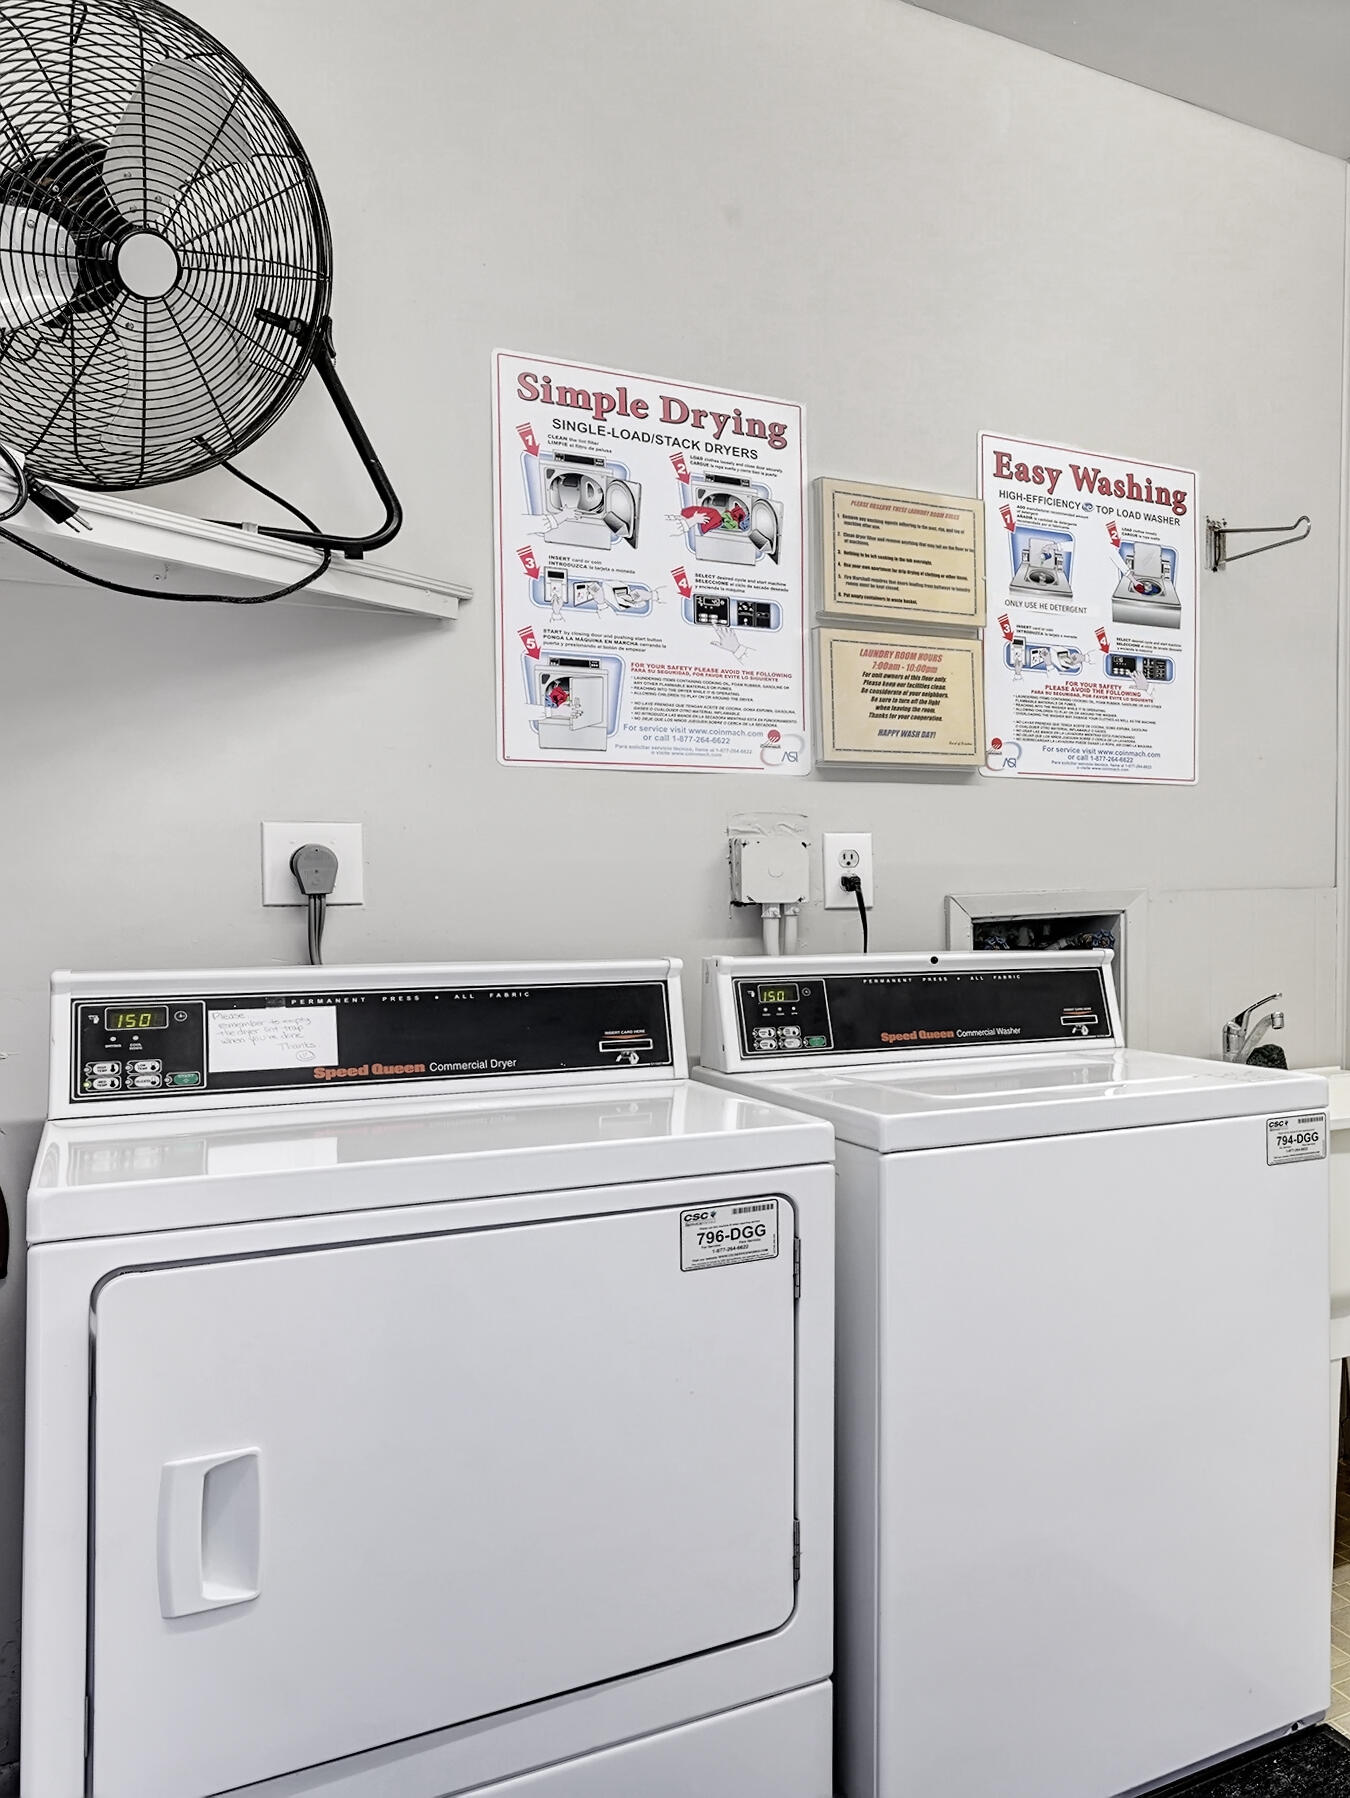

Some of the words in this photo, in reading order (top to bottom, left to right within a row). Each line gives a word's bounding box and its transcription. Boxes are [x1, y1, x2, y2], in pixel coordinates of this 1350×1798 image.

[517, 372, 649, 421] Simple
[660, 396, 787, 450] Drying
[552, 418, 700, 451] SINGLE-LOAD/STACK
[705, 442, 758, 459] DRYERS
[677, 464, 686, 474] 2
[993, 451, 1062, 494] Easy
[1069, 464, 1187, 516] Washing
[999, 490, 1081, 510] HIGH-EFFICIENCY
[1096, 505, 1114, 514] TOP
[1117, 509, 1141, 519] LOAD
[1144, 513, 1180, 526] WASHER
[1111, 531, 1117, 539] 2
[526, 558, 534, 568] 3
[678, 578, 687, 588] 4
[1050, 604, 1087, 613] DETERGENT
[1004, 624, 1010, 633] 3
[526, 638, 535, 649] 5
[860, 649, 894, 658] LAUNDRY
[895, 651, 917, 659] ROOM
[918, 653, 942, 662] HOURS
[872, 661, 900, 670] 7:00am
[907, 664, 938, 673] 10:00pm
[688, 728, 764, 737] www.coinmach.com
[900, 730, 921, 738] WASH
[672, 736, 730, 744] 1-877-264-6622
[1098, 750, 1160, 758] www.coinmach.com
[763, 991, 784, 1002] 150
[118, 1014, 151, 1028] 150
[881, 1031, 917, 1043] Speed
[919, 1030, 954, 1039] Queen
[956, 1028, 995, 1038] Commercial
[996, 1027, 1021, 1035] Washer
[314, 1064, 369, 1080] Speed
[371, 1063, 426, 1076] Queen
[429, 1060, 488, 1072] Commercial
[491, 1059, 517, 1070] Dryer
[1277, 1132, 1318, 1146] 794-DGG
[684, 1212, 708, 1222] CSC
[697, 1224, 766, 1245] 796-DGG
